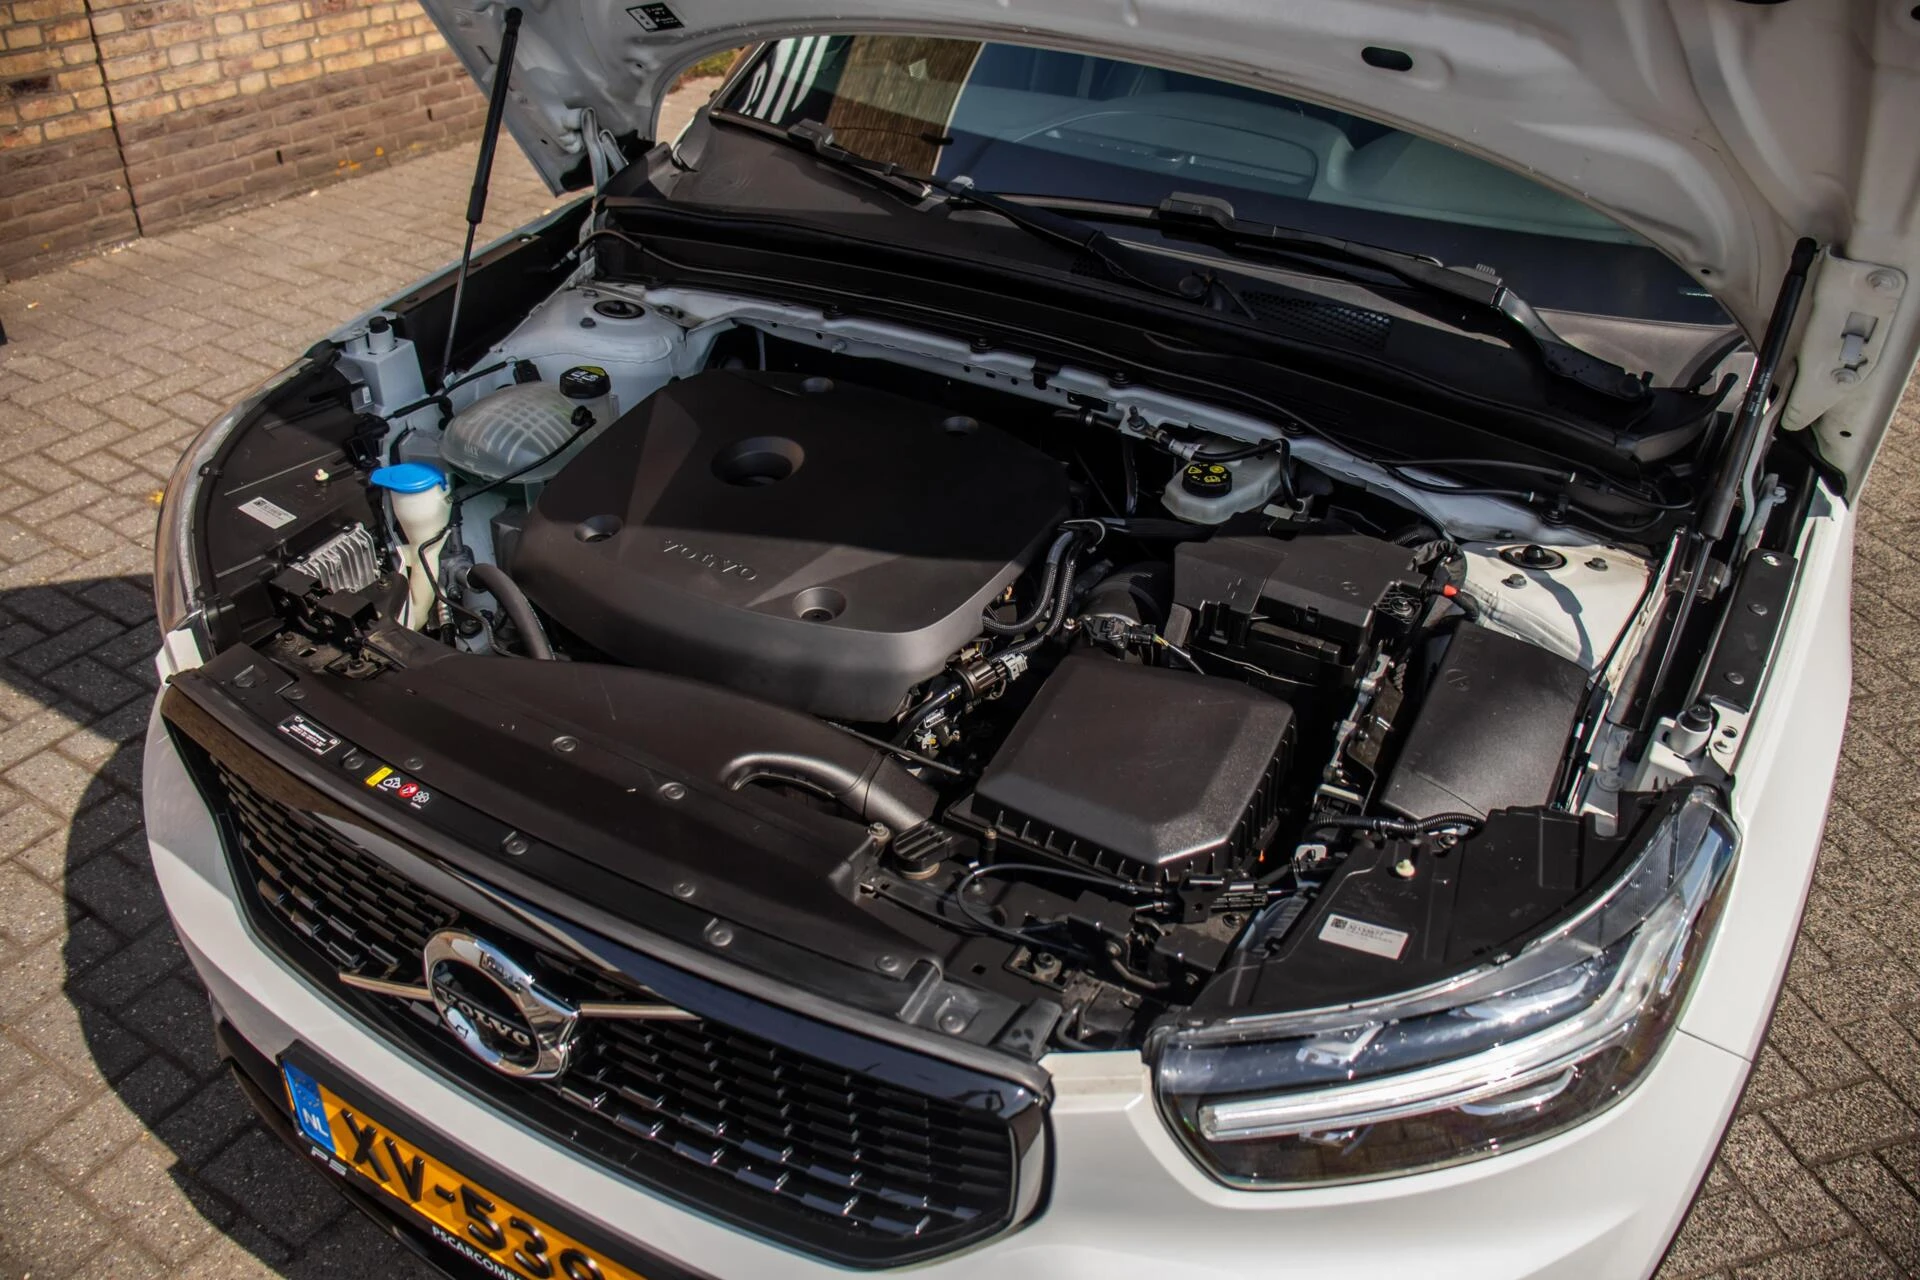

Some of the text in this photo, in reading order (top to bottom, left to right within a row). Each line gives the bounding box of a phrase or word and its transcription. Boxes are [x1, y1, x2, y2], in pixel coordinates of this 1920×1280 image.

[663, 539, 758, 581] VOLVO
[436, 986, 531, 1046] VOLVO
[302, 1107, 330, 1138] NL
[431, 1224, 523, 1280] PSCARCOM
